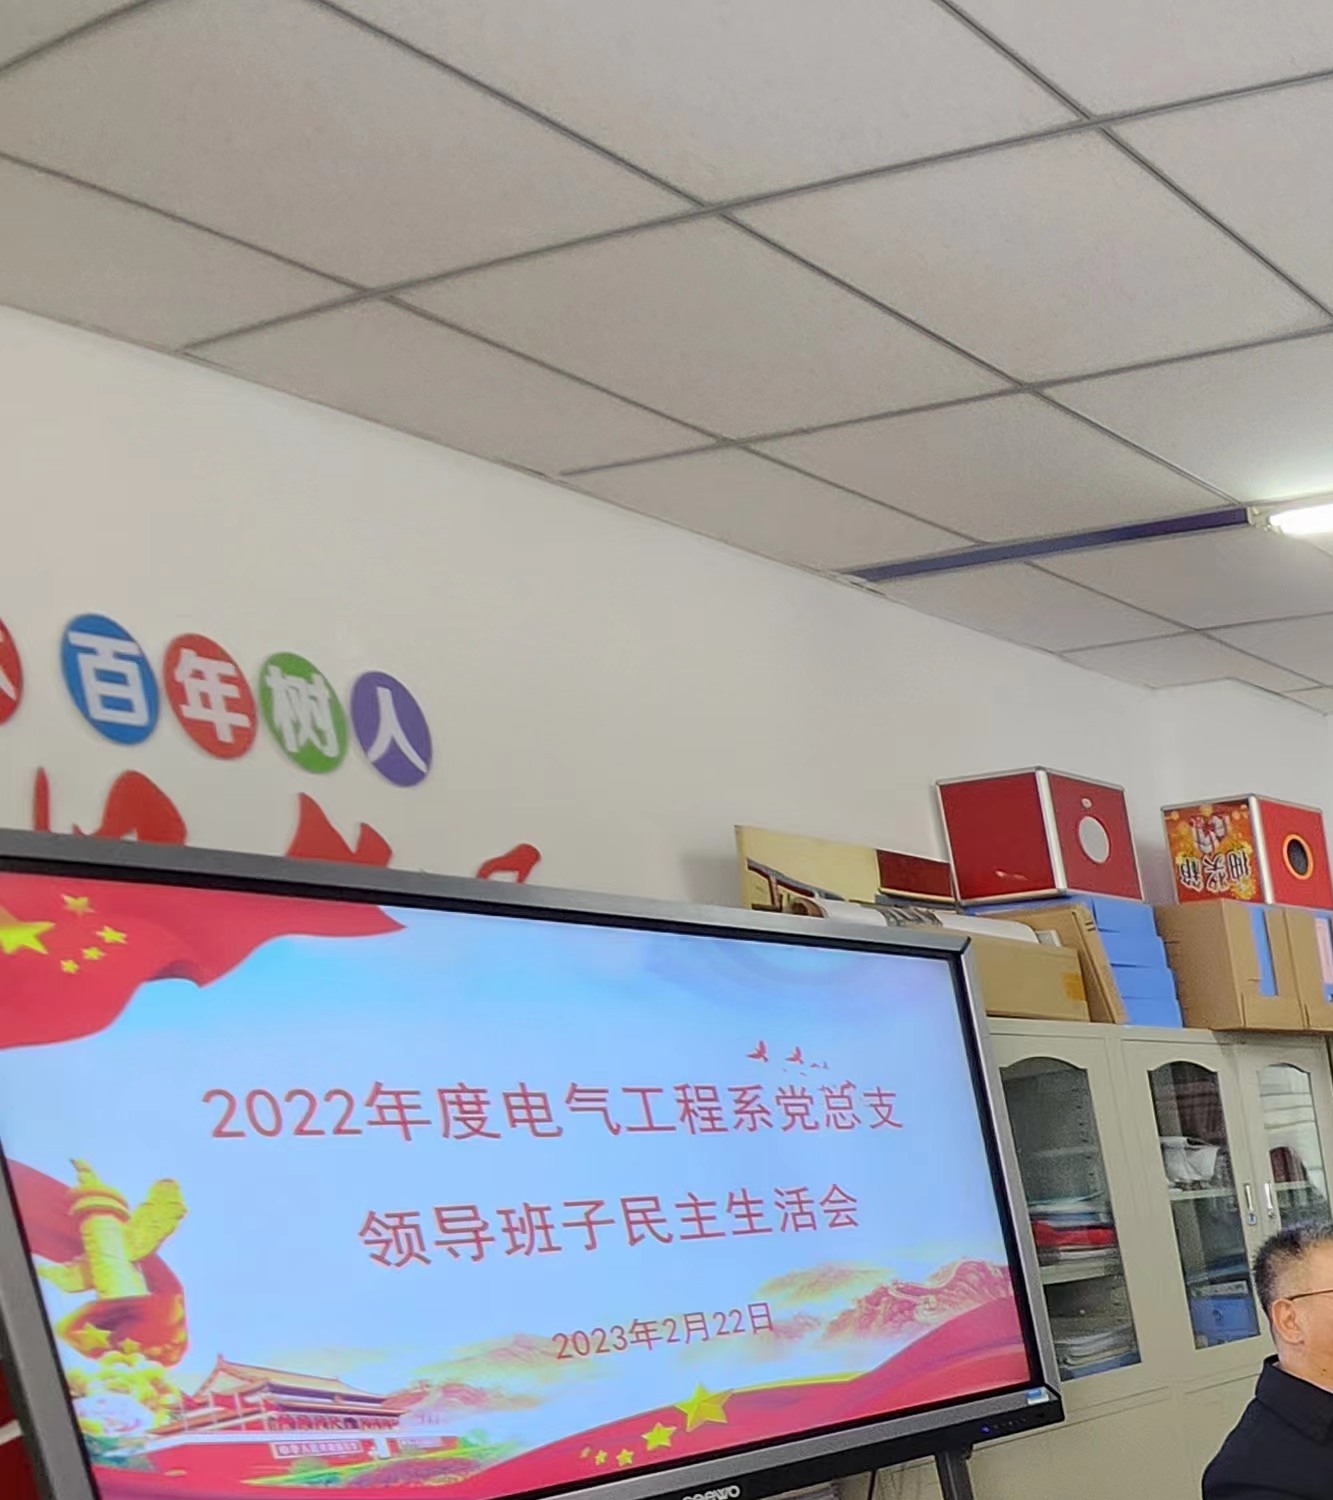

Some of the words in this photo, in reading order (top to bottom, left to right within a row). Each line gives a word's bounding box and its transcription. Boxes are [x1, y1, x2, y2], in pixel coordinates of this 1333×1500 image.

[68, 632, 428, 774] 百年树人
[202, 1080, 904, 1142] 2022年度电气工程系党总支
[358, 1183, 859, 1268] 领导班子民主生活会
[551, 1302, 775, 1361] 2023年2月22日
